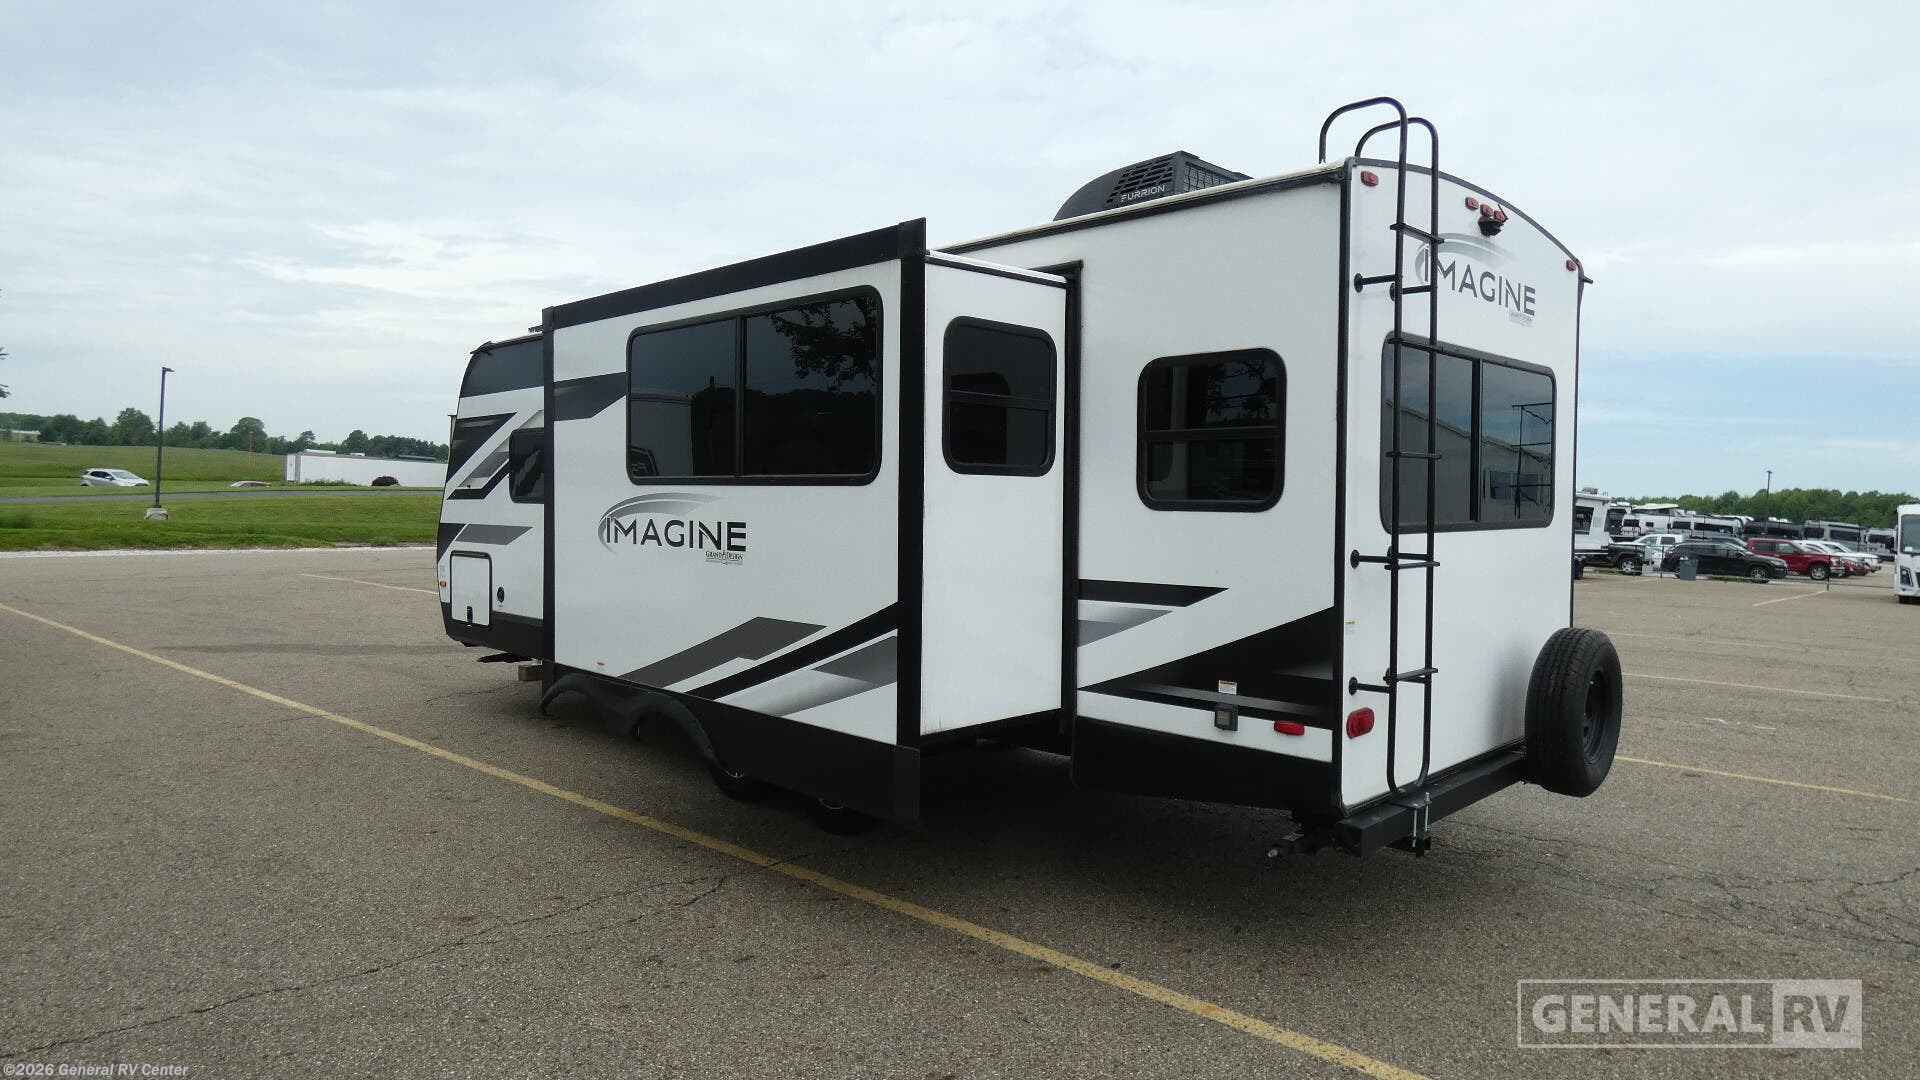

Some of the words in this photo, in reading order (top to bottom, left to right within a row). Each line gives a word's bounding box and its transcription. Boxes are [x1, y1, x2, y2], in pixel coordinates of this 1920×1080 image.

[1120, 185, 1165, 202] FURRION
[1424, 248, 1536, 316] IMAGINE
[606, 517, 747, 552] IMAGINE
